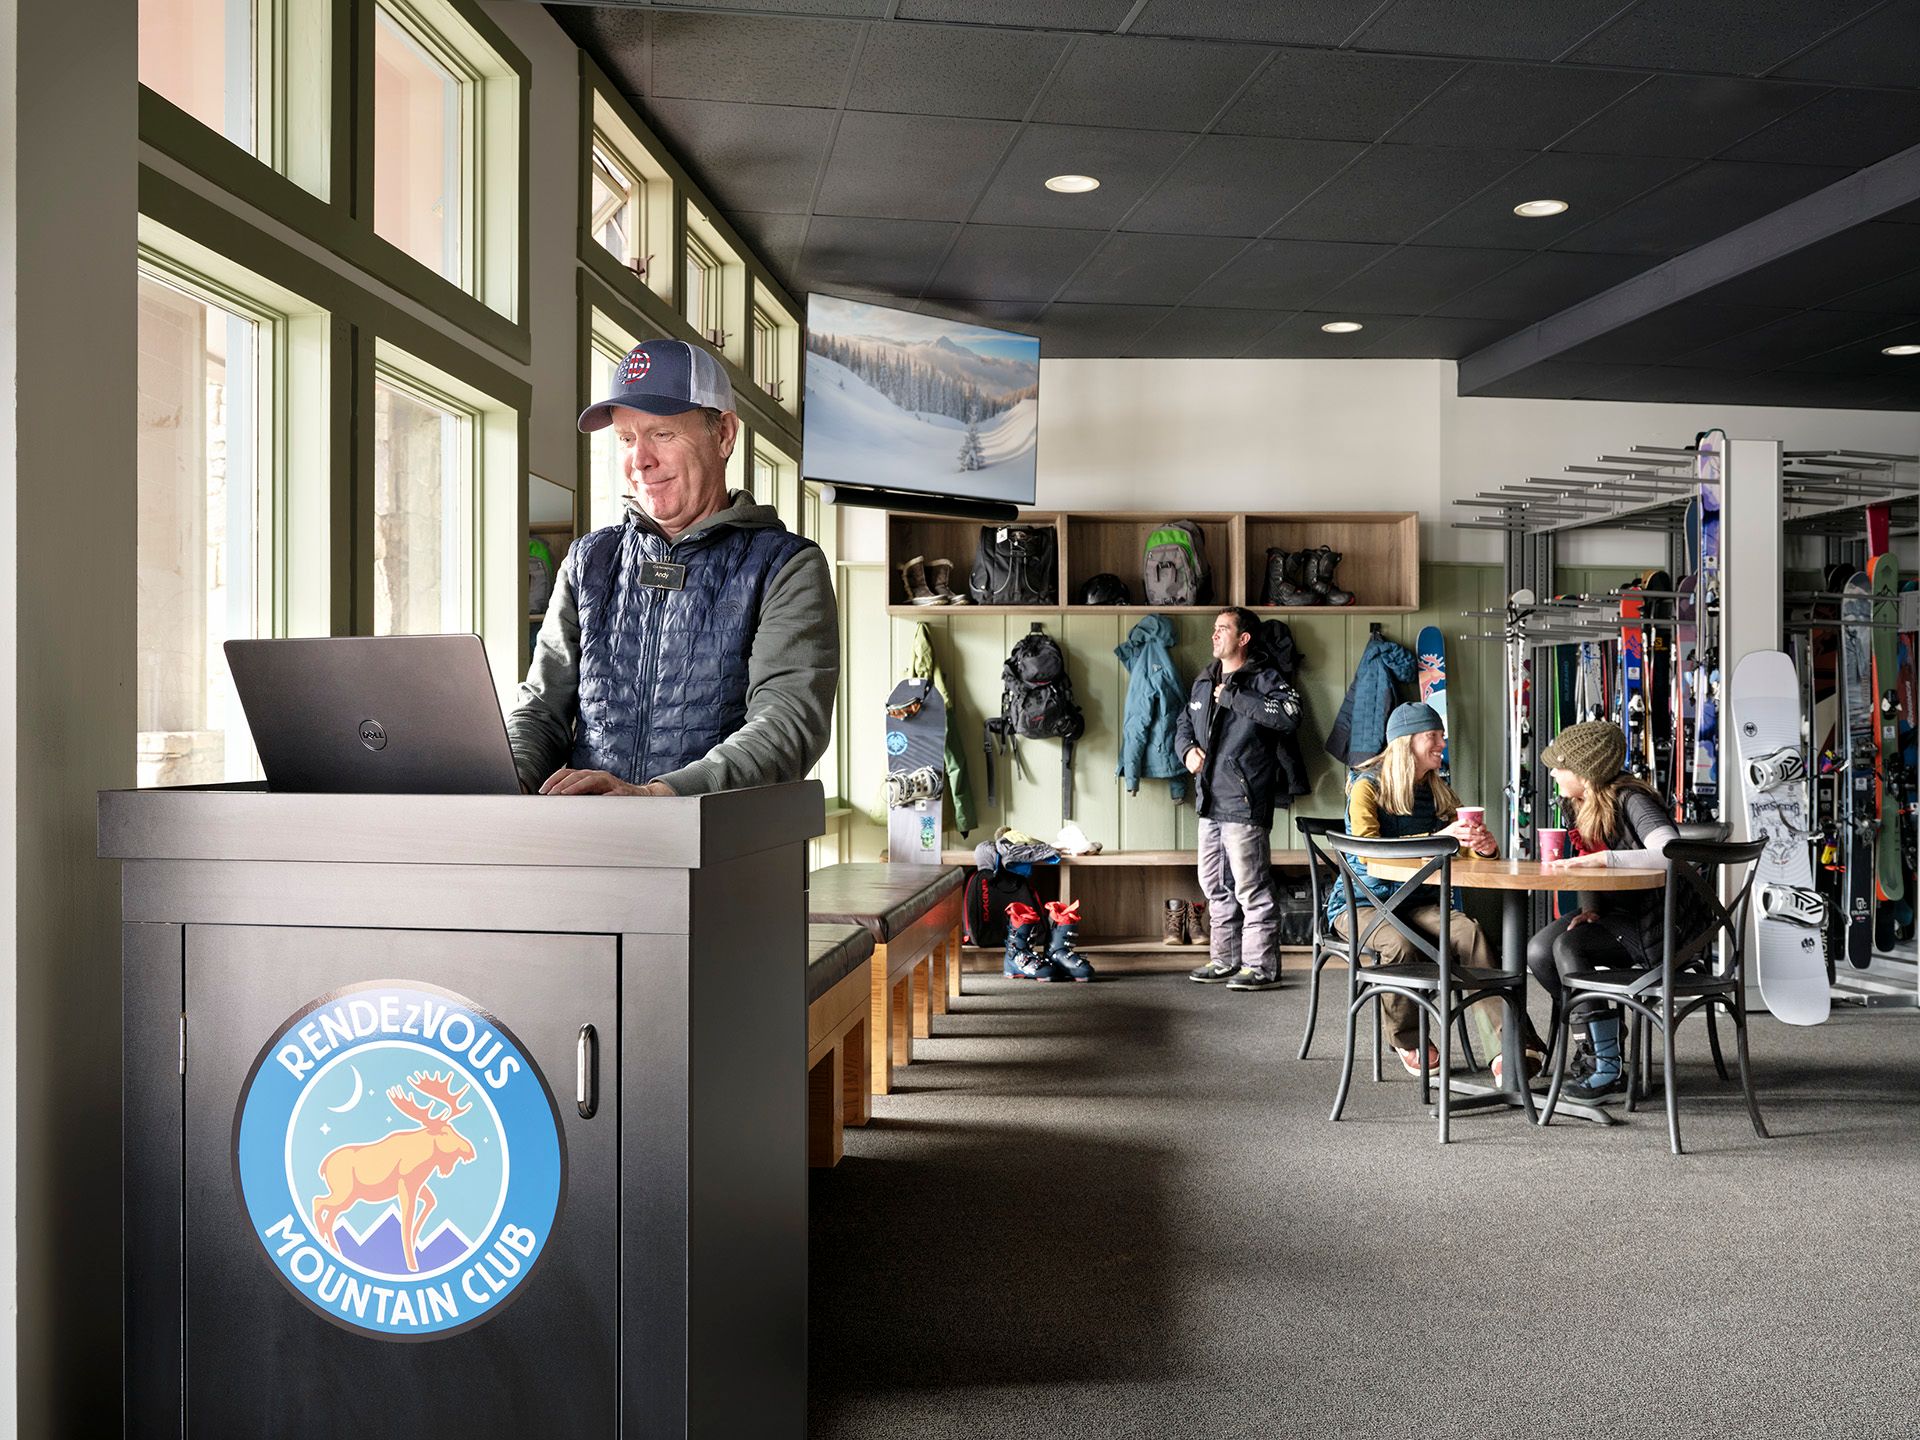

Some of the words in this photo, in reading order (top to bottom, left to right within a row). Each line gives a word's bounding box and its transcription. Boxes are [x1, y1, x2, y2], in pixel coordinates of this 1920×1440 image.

[654, 571, 670, 580] Andy
[362, 730, 384, 739] DELL
[981, 878, 990, 922] DAKINE
[265, 1214, 459, 1326] MOUNTAIN
[462, 1222, 537, 1305] CLUB
